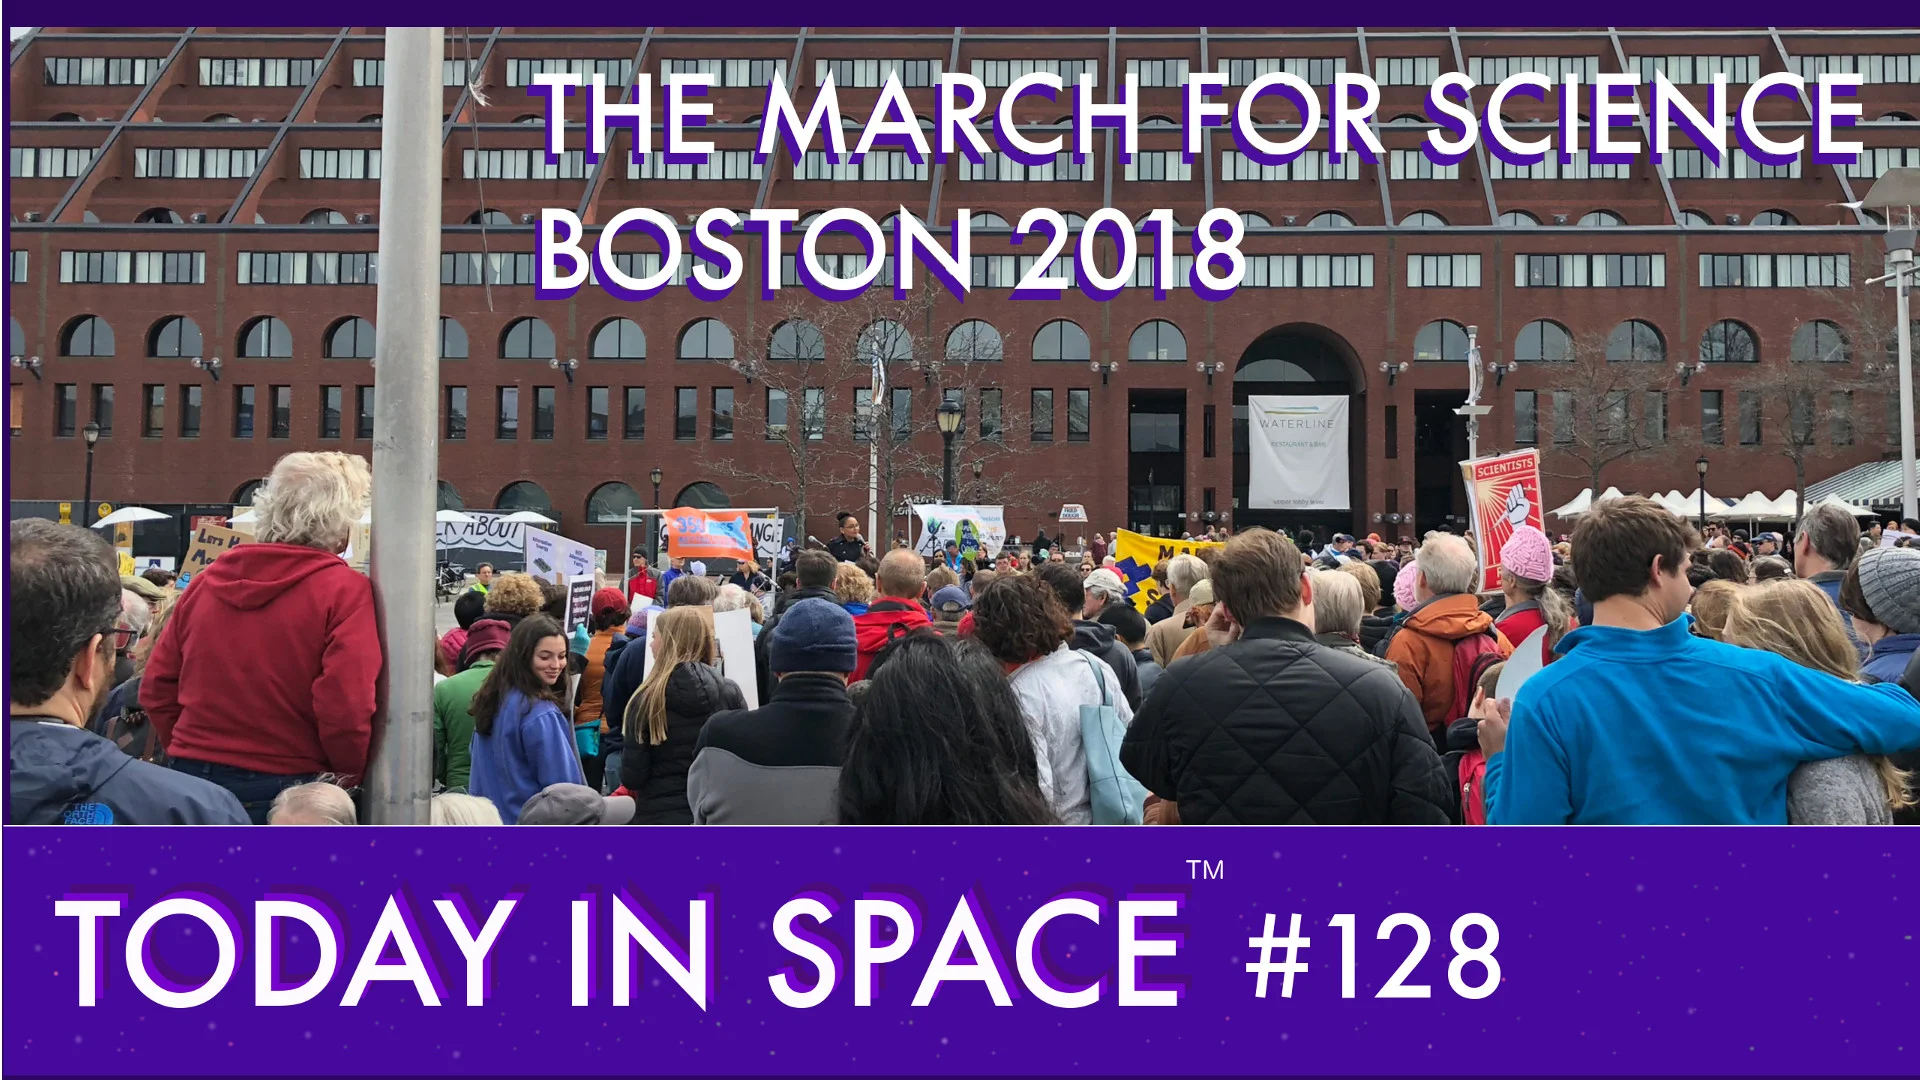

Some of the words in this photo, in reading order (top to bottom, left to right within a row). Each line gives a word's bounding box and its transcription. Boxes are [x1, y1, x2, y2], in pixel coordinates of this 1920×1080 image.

[1260, 419, 1335, 428] WATERLINE
[1477, 457, 1534, 478] SCIENTISTS
[74, 803, 96, 811] THE
[63, 810, 96, 818] ORTH
[64, 817, 96, 825] FACE
